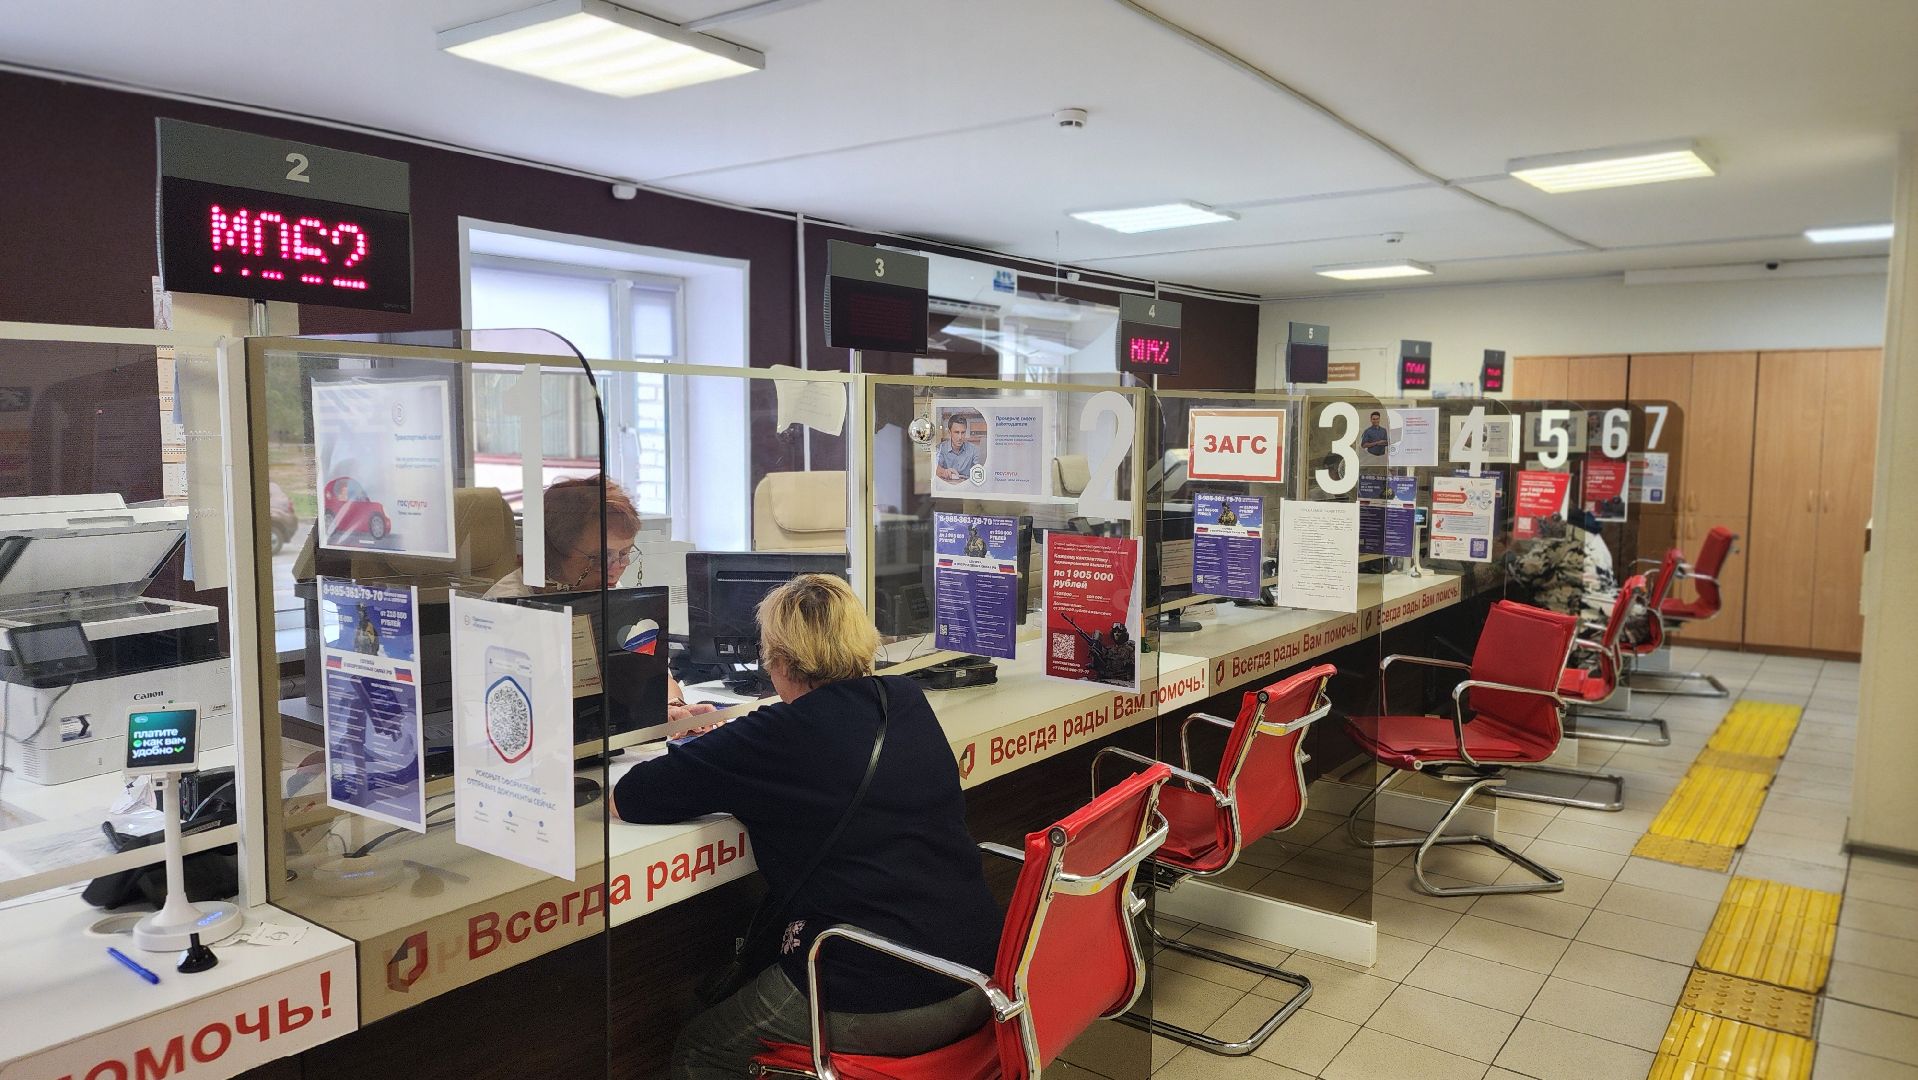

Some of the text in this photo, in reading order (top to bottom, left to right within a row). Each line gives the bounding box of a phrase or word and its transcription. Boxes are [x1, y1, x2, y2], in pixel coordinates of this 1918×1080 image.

[285, 153, 310, 183] 2
[874, 257, 885, 277] 3
[1148, 304, 1156, 318] 4
[1308, 327, 1314, 339] 5
[1449, 406, 1490, 477] 4
[1537, 409, 1570, 469] 5
[1601, 407, 1630, 458] 6
[1644, 405, 1668, 449] 7
[1077, 390, 1136, 520] 2
[1203, 434, 1268, 455] ЗАГС
[1314, 401, 1360, 494] 3
[503, 362, 546, 588] 1
[1053, 578, 1088, 590] рублей
[1067, 569, 1072, 578] 1
[1073, 570, 1092, 579] 905
[1093, 571, 1114, 582] 000
[1402, 599, 1421, 616] рады
[1422, 593, 1435, 608] Вам
[1436, 582, 1460, 602] помочь!
[1232, 616, 1359, 678] Всегда рады Вам помочь!
[133, 690, 164, 701] Canon
[989, 667, 1205, 766] Всегда рады Вам помочь!
[133, 728, 179, 739] платите
[143, 737, 187, 746] как вам
[132, 746, 174, 759] удобно
[533, 798, 557, 811] СЕЙЧАС
[468, 832, 746, 961] Всегда рады
[58, 970, 333, 1080] омочь!
